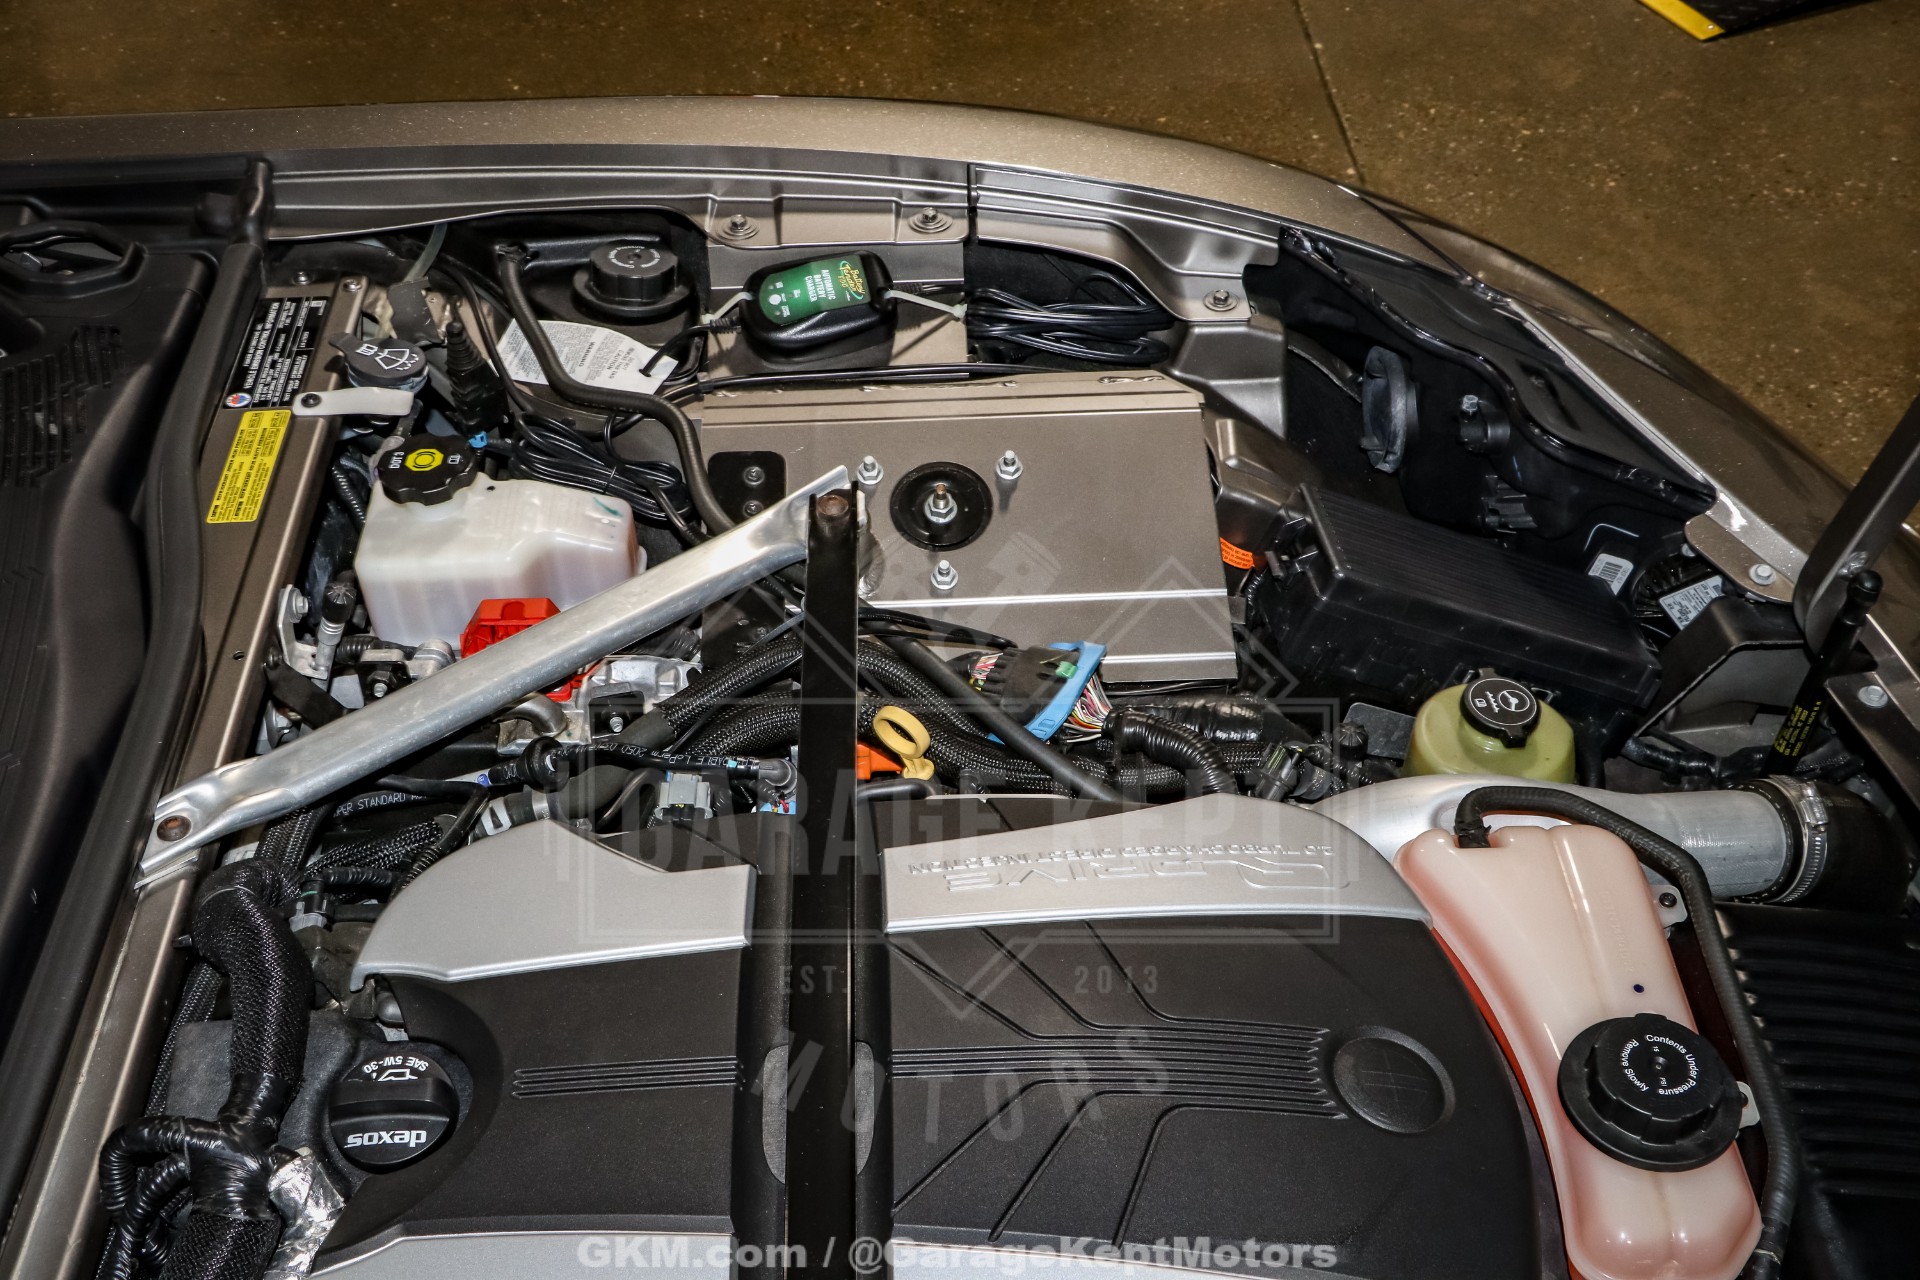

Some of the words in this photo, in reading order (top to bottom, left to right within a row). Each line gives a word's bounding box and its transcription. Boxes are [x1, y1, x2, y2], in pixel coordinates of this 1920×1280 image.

[805, 276, 818, 303] CHARGER
[813, 274, 826, 299] BATTERY
[821, 269, 836, 300] AUTOMATIC
[389, 456, 402, 468] DOT
[621, 744, 647, 757] 2050
[357, 793, 406, 810] STANDARD
[1621, 1038, 1639, 1067] Remove
[1645, 1034, 1686, 1054] Contents
[362, 1055, 403, 1073] 5W-30
[406, 1056, 428, 1071] SAE
[1685, 1054, 1699, 1079] Under
[1624, 1068, 1650, 1092] Slowly
[1659, 1078, 1696, 1096] Pressure
[343, 1130, 427, 1148] dexos
